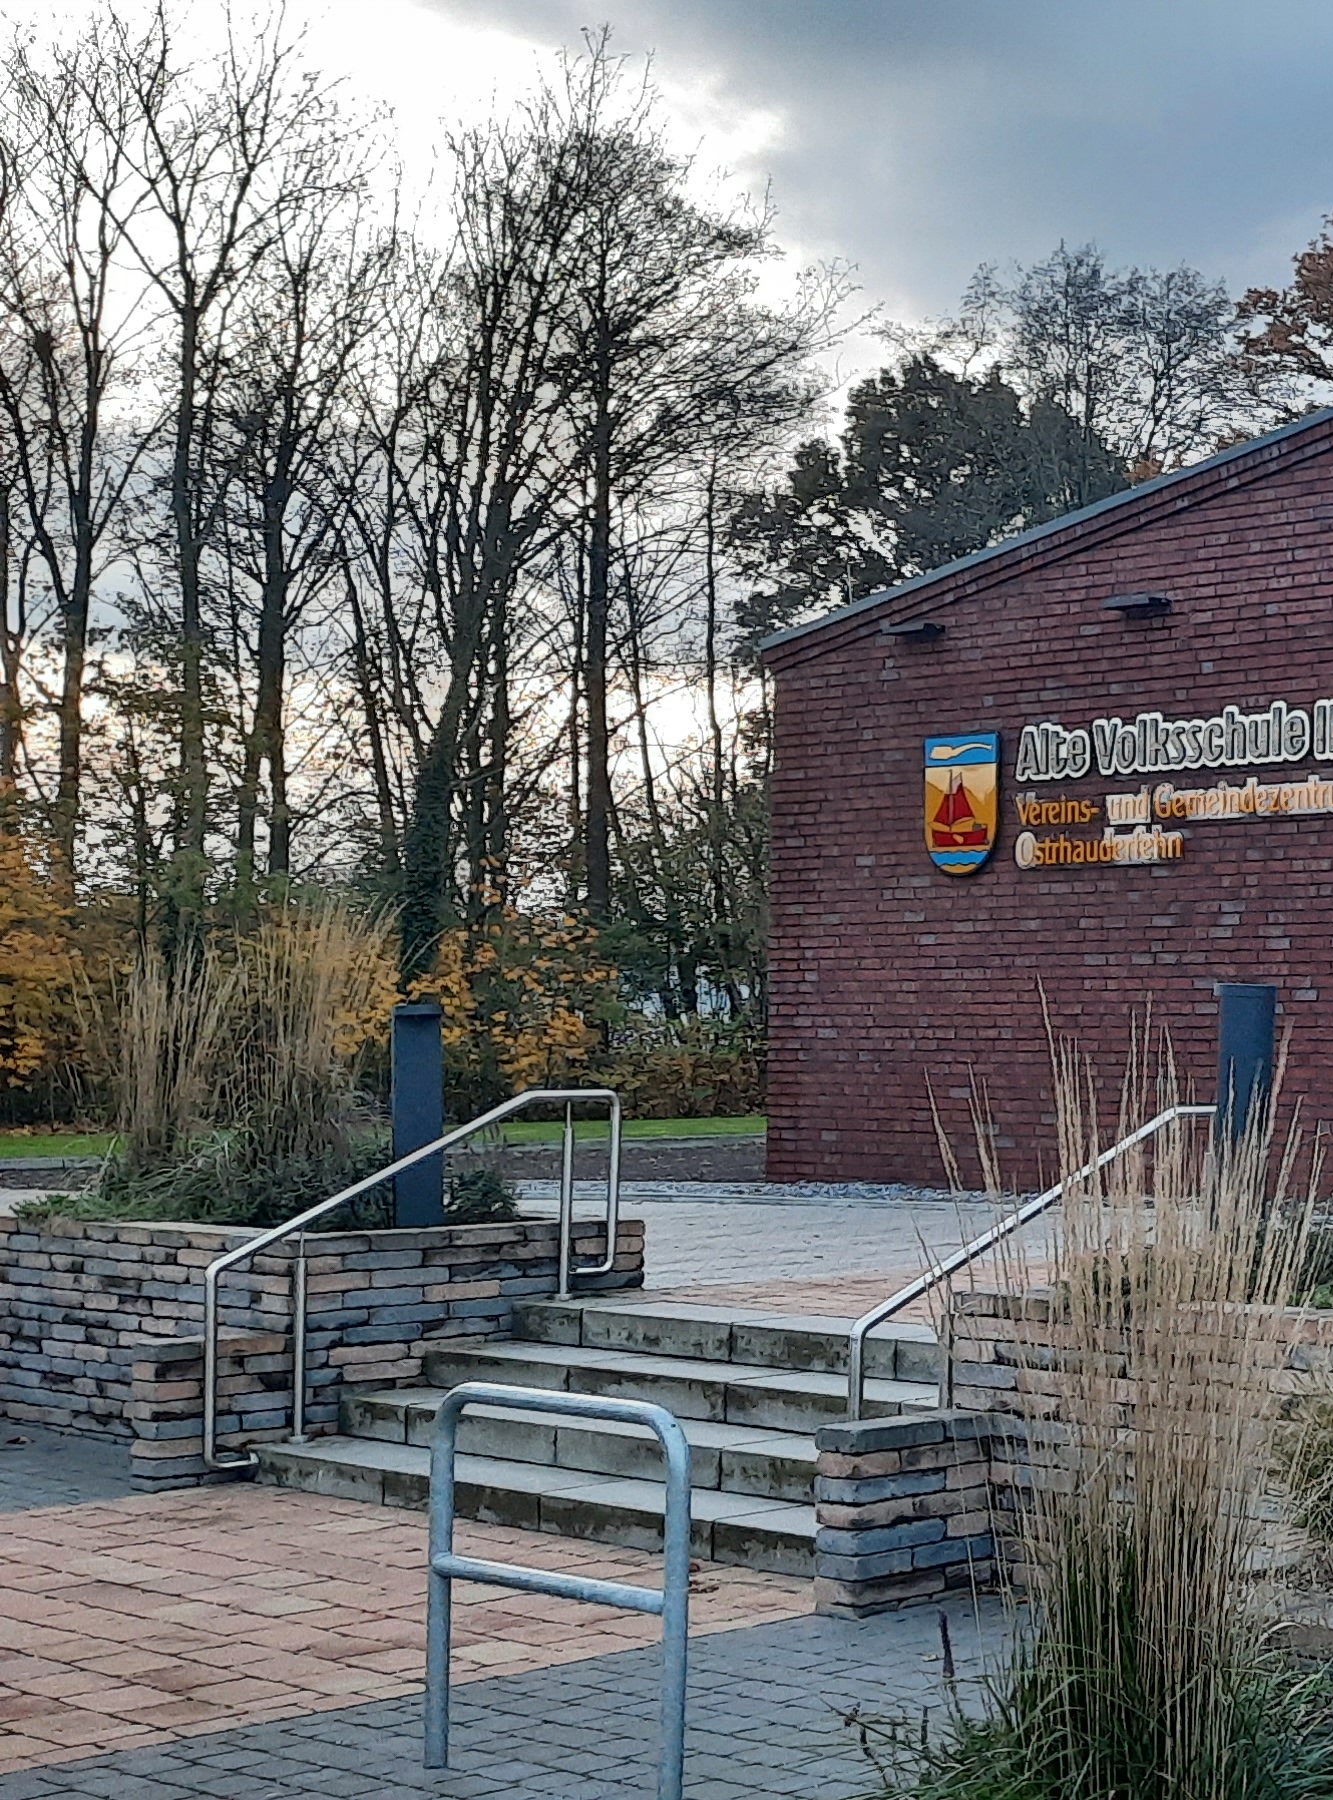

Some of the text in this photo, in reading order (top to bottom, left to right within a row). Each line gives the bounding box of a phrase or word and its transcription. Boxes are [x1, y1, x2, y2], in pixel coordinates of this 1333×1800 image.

[1016, 725, 1089, 780] Alte
[1095, 702, 1307, 774] Volksschule
[1015, 792, 1099, 826] Vereins-
[1107, 786, 1150, 823] und
[1015, 826, 1184, 868] Ostrhauderfehn
